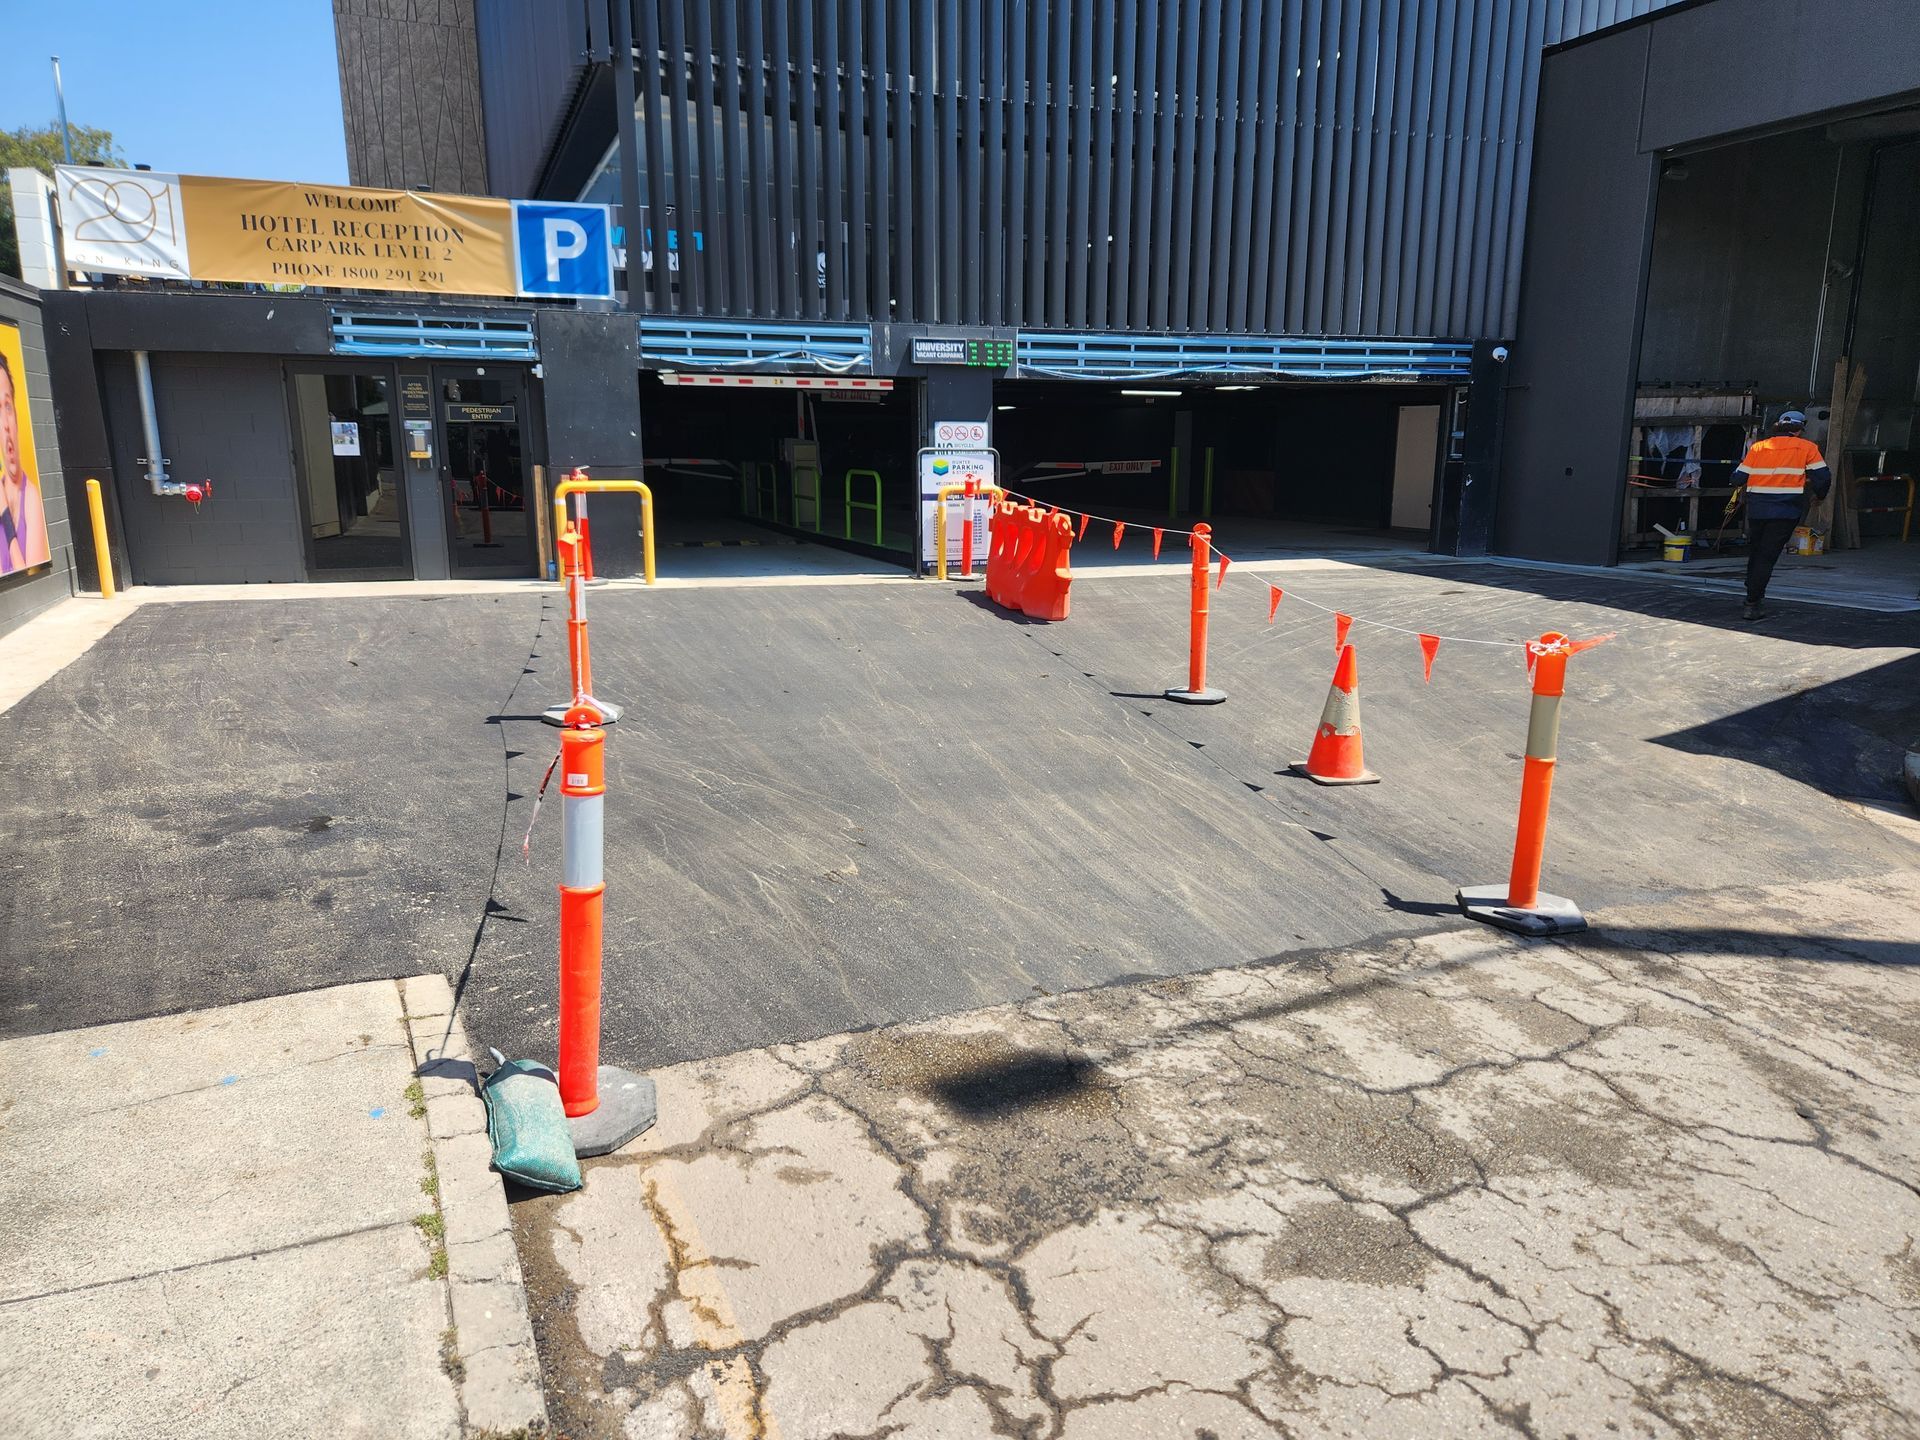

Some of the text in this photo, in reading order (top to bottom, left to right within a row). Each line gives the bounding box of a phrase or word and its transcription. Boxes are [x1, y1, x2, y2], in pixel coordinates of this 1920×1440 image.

[69, 178, 177, 247] 291
[304, 193, 403, 213] WELCOME
[241, 214, 465, 245] HOTEL RECEPTION
[265, 236, 453, 262] CARPARK LEVEL 2
[543, 217, 588, 282] P
[75, 255, 179, 270] ON KING
[272, 261, 446, 284] PHONE 1800 291 291
[915, 341, 965, 352] UNIVERSITY
[937, 442, 954, 456] NO
[1109, 461, 1144, 471] EXIT ONLY
